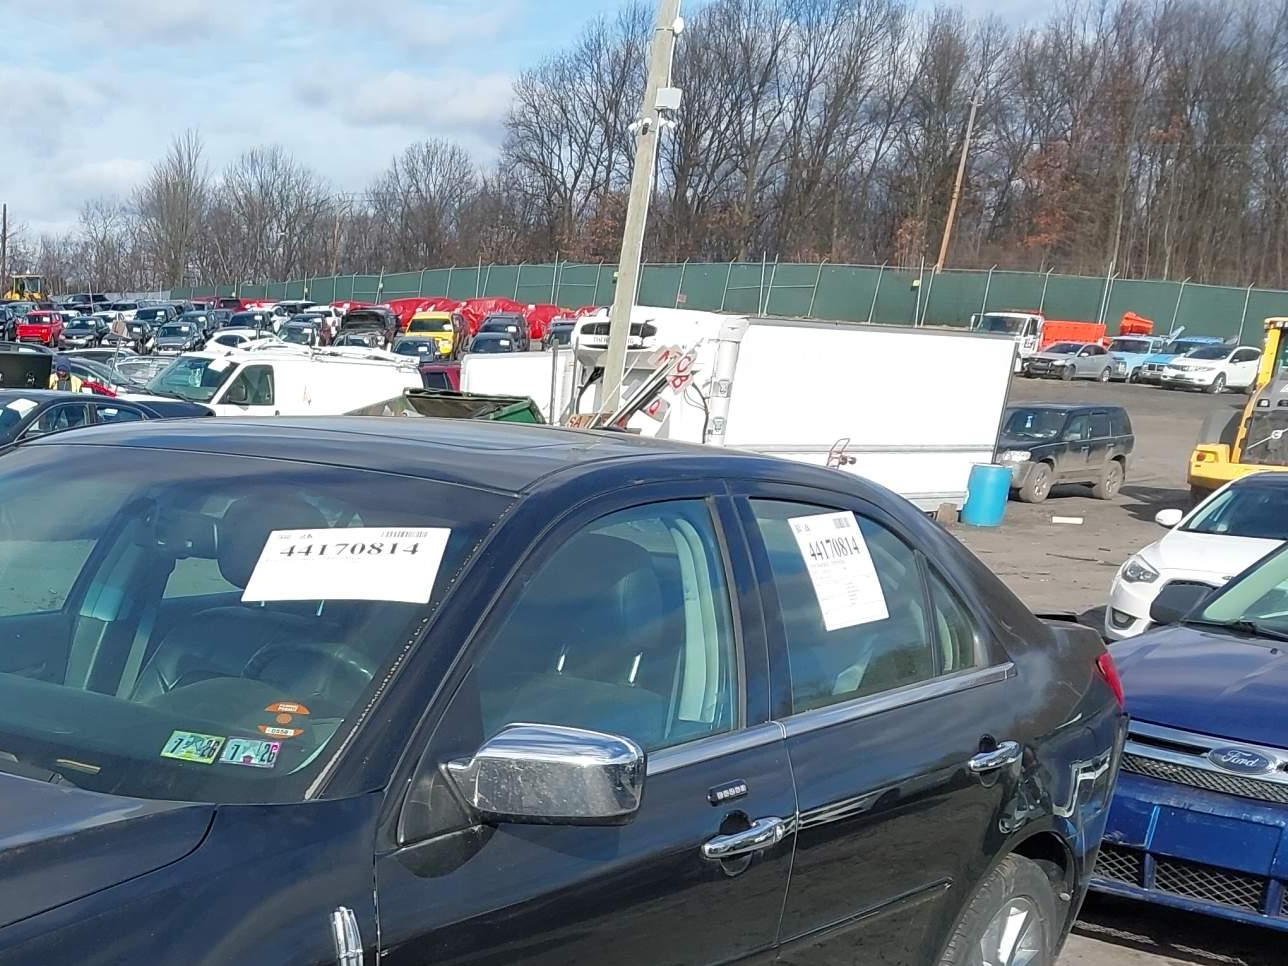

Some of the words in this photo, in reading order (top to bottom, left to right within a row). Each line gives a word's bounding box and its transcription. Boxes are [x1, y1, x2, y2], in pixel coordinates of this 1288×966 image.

[280, 542, 421, 557] 44170814
[809, 536, 861, 561] 44170814
[1222, 750, 1260, 766] Ford
